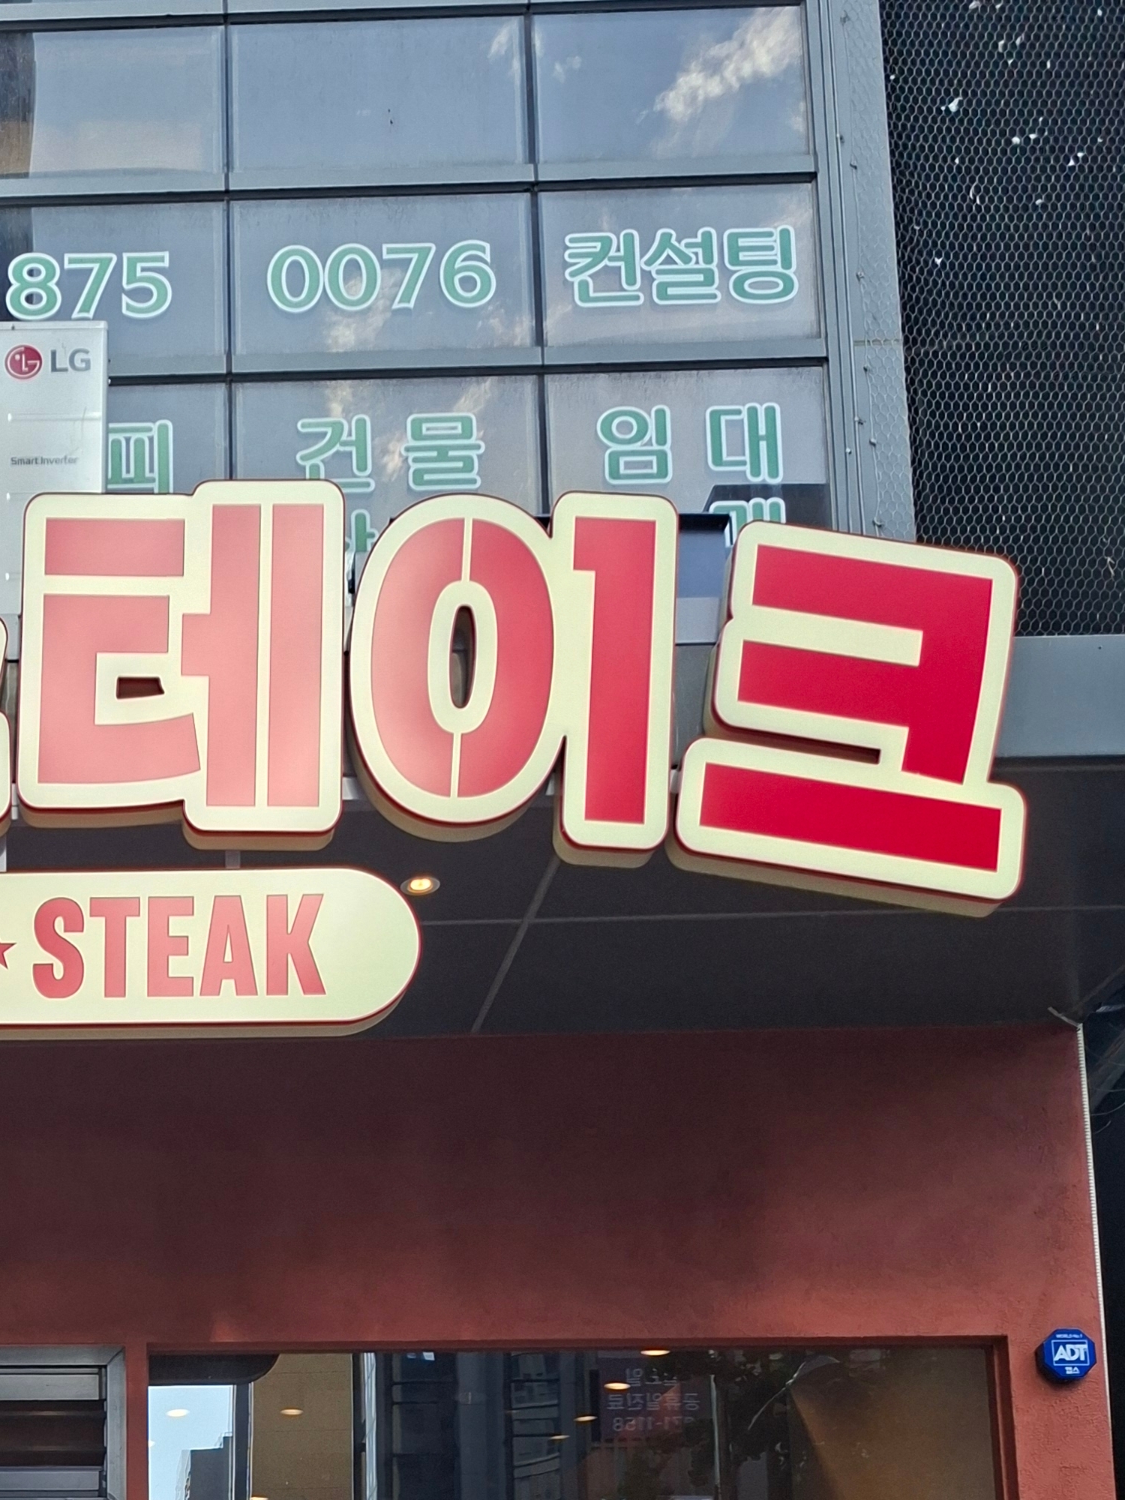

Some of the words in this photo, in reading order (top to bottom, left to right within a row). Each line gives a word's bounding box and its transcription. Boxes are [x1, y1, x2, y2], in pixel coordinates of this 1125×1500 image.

[5, 250, 173, 321] 875
[266, 239, 497, 313] 0076
[564, 225, 800, 307] 컨설팅
[50, 348, 91, 373] LG
[10, 456, 39, 466] Smart
[31, 893, 326, 1000] STEAK
[1053, 1343, 1088, 1361] ADT
